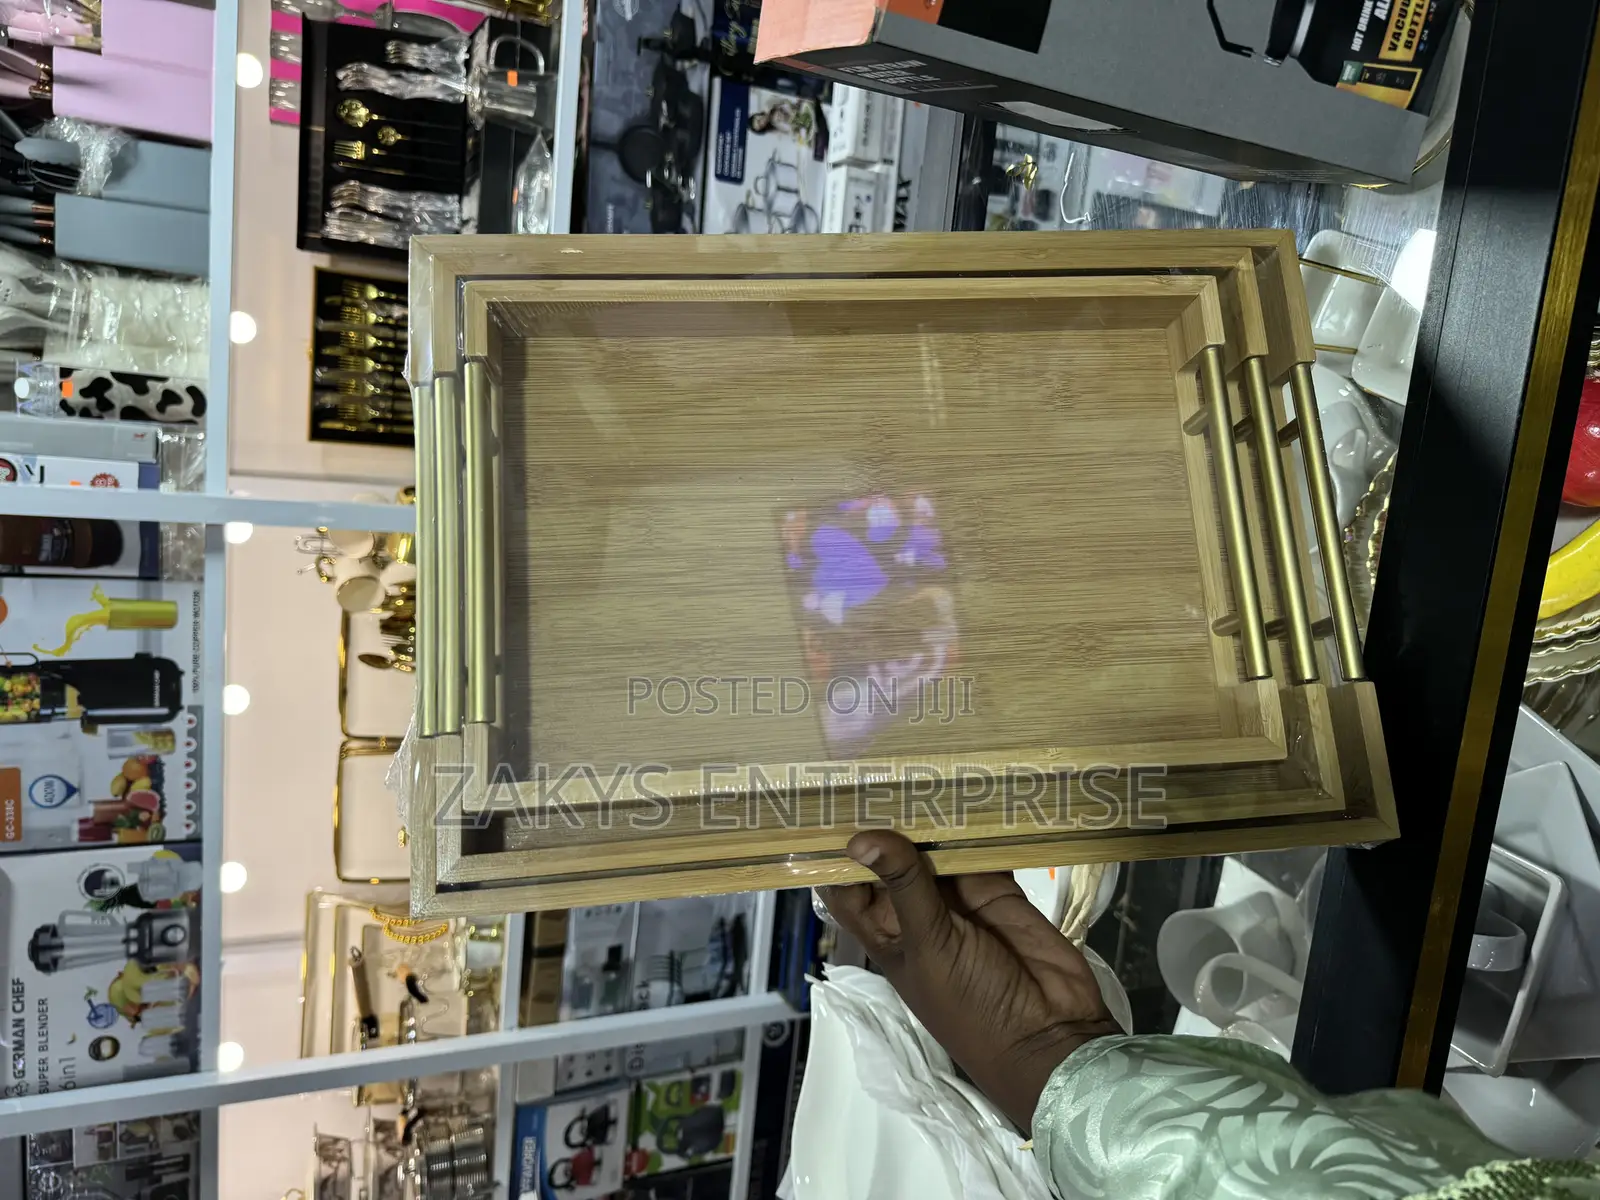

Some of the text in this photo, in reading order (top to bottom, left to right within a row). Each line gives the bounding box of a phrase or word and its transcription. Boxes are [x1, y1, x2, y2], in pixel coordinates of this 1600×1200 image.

[1351, 31, 1364, 52] HOT
[11, 977, 26, 1079] GERMAN CHEF
[37, 997, 49, 1094] SUPER BLENDER
